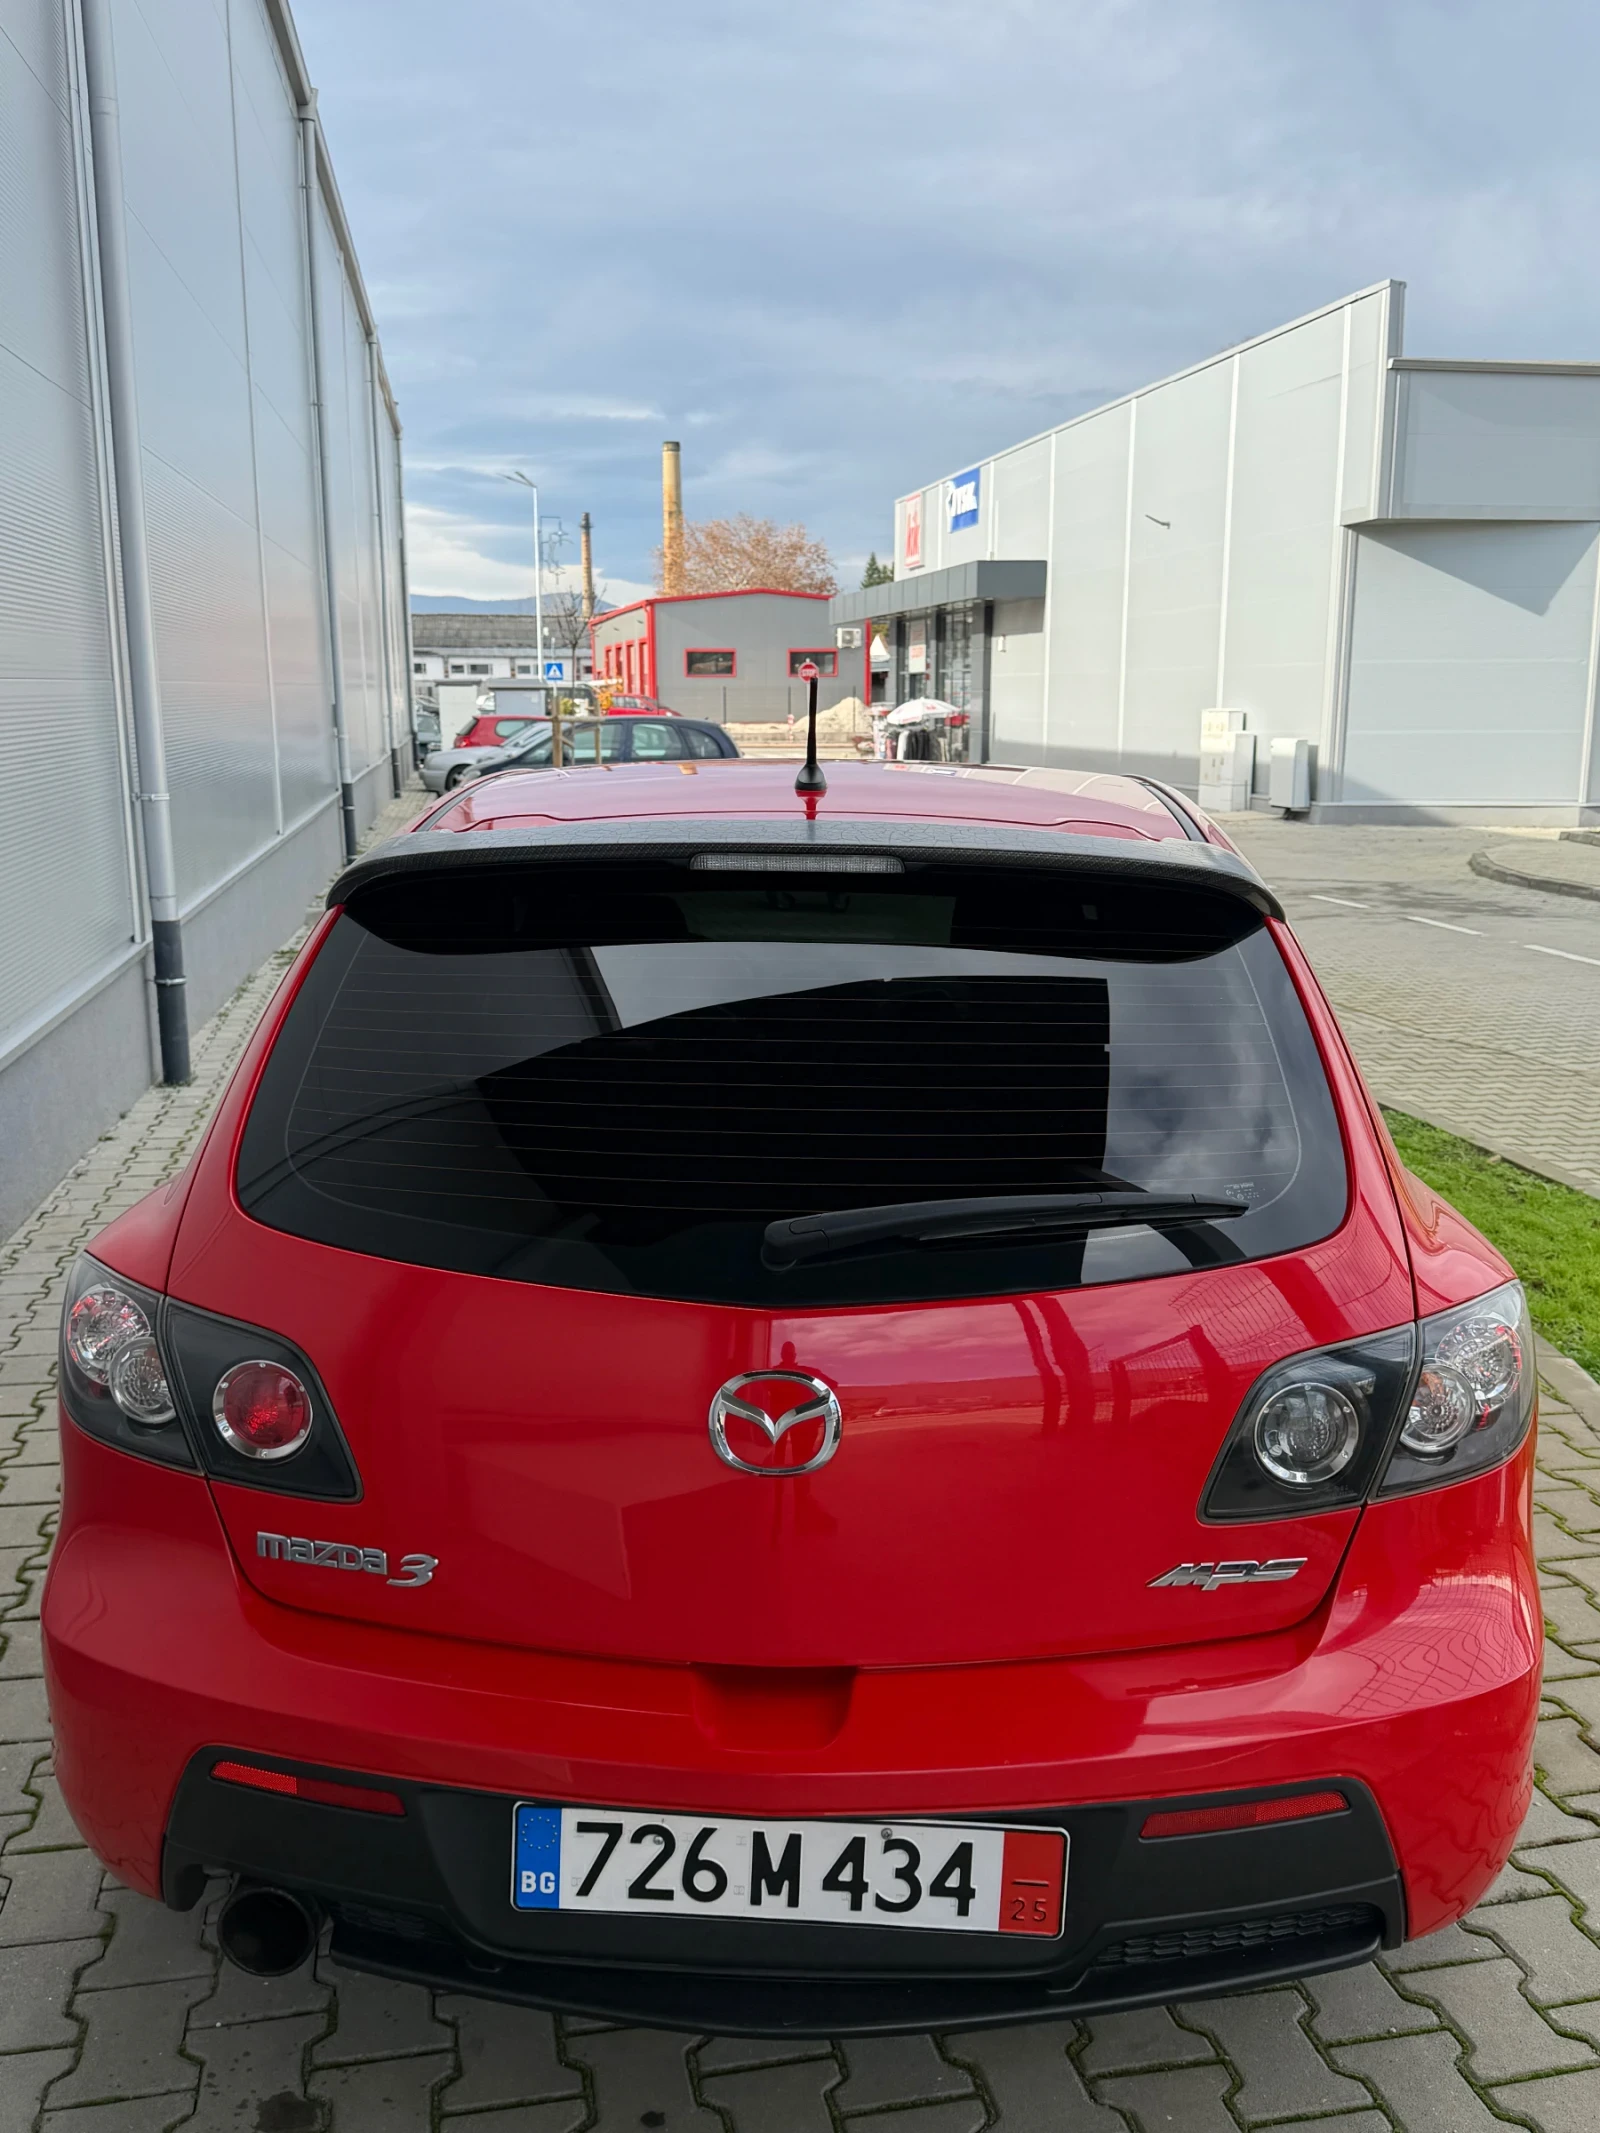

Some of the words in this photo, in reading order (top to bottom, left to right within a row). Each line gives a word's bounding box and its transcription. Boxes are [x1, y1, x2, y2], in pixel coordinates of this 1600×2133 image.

[1147, 1557, 1308, 1591] MPS
[521, 1870, 556, 1894] BG
[575, 1821, 728, 1903] 726
[750, 1830, 802, 1908] M
[822, 1835, 977, 1917] 434
[1010, 1898, 1048, 1922] 25
